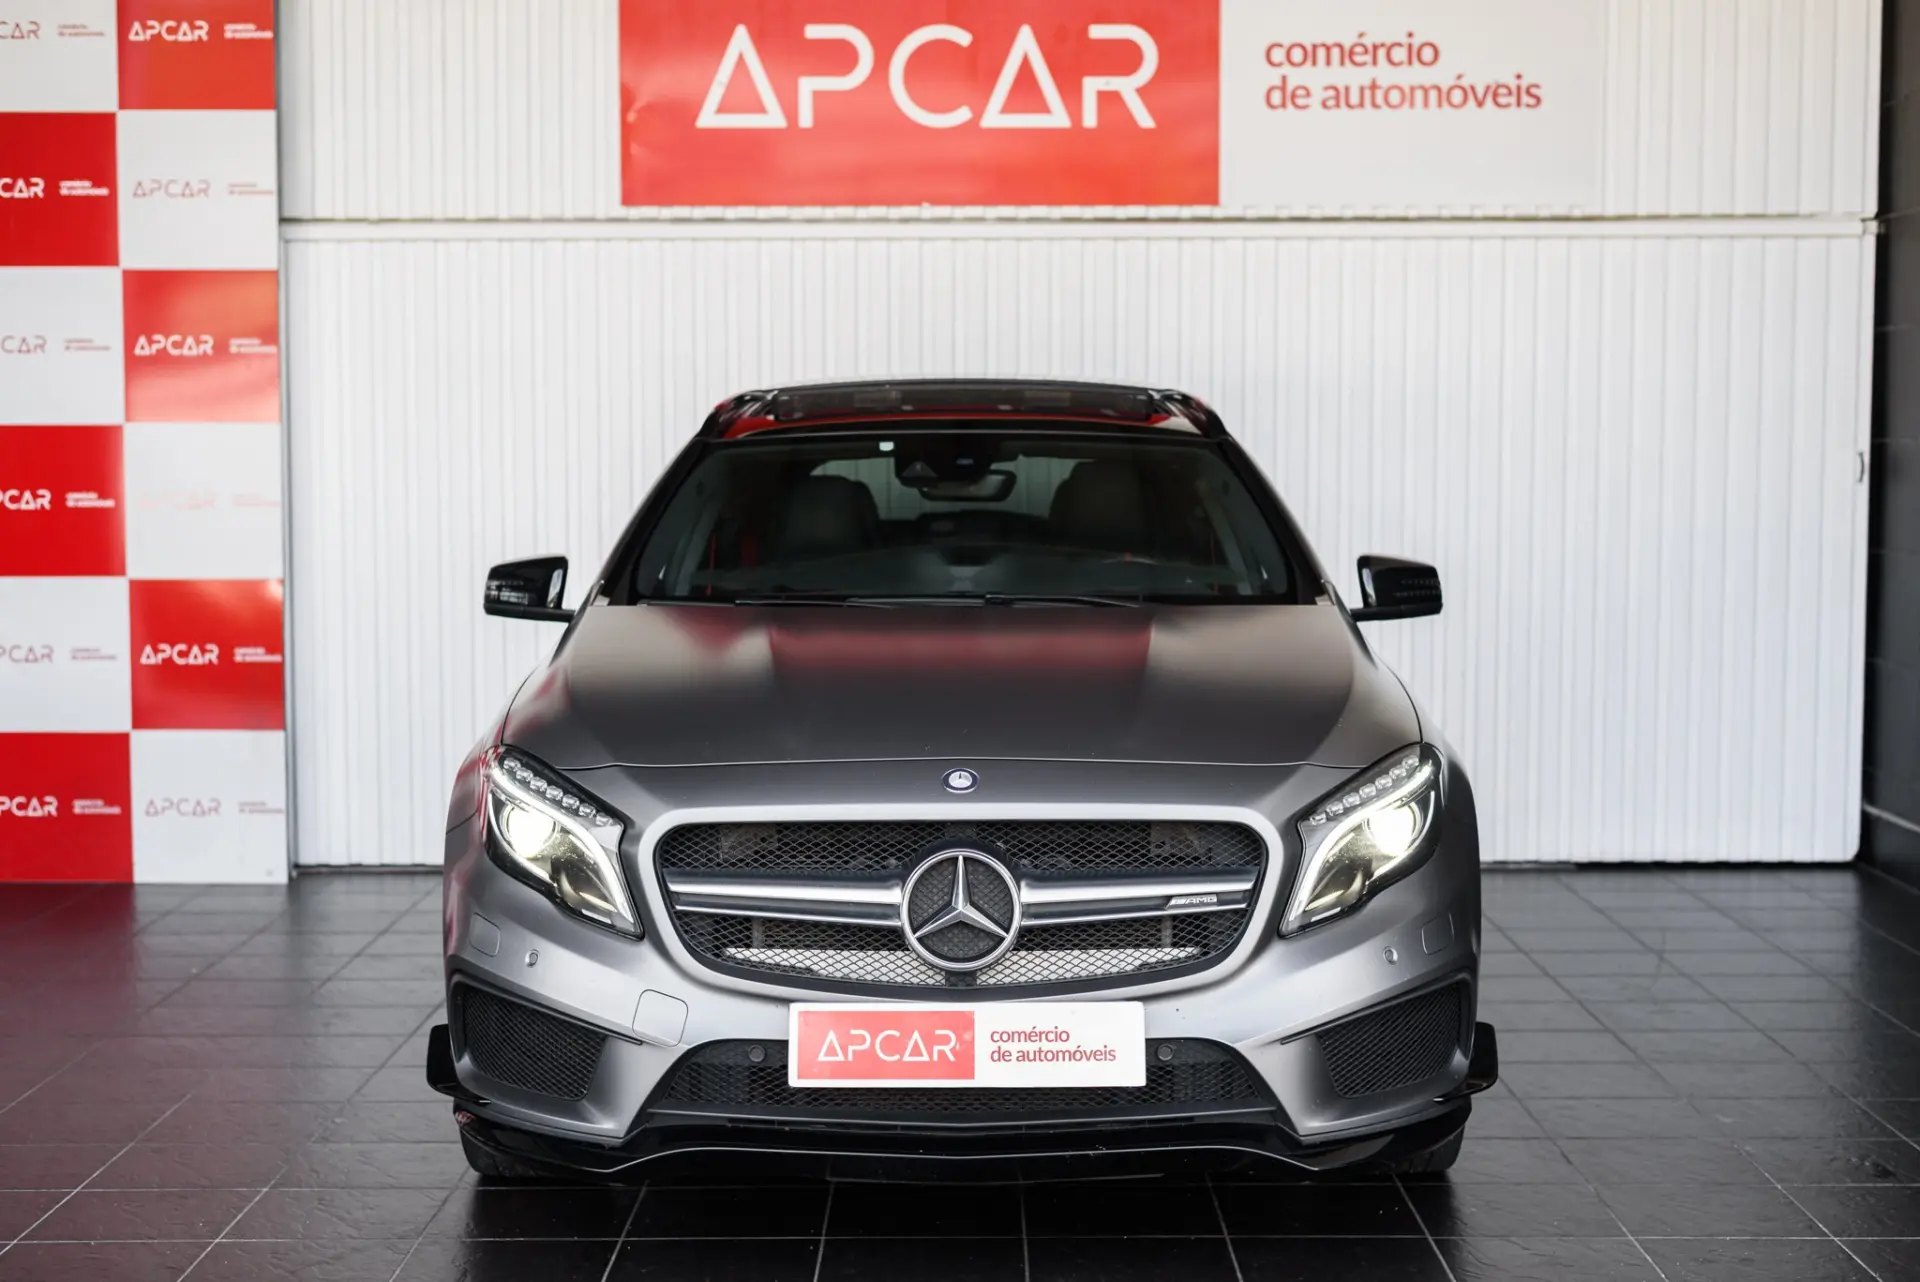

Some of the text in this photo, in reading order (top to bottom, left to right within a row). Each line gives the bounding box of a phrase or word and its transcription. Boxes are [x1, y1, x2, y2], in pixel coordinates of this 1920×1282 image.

[128, 20, 209, 42] APCAR
[1265, 31, 1439, 68] comércio
[696, 24, 1158, 130] APCAR
[1265, 73, 1542, 110] de automóveis
[132, 179, 211, 198] APCAR
[133, 334, 214, 356] APCAR
[0, 488, 52, 511] CAR
[139, 643, 219, 665] APCAR
[144, 797, 222, 817] APCAR
[1184, 896, 1217, 906] AMG
[990, 1025, 1070, 1043] comércio
[816, 1029, 957, 1062] APCAR
[990, 1044, 1117, 1063] de automóveis
